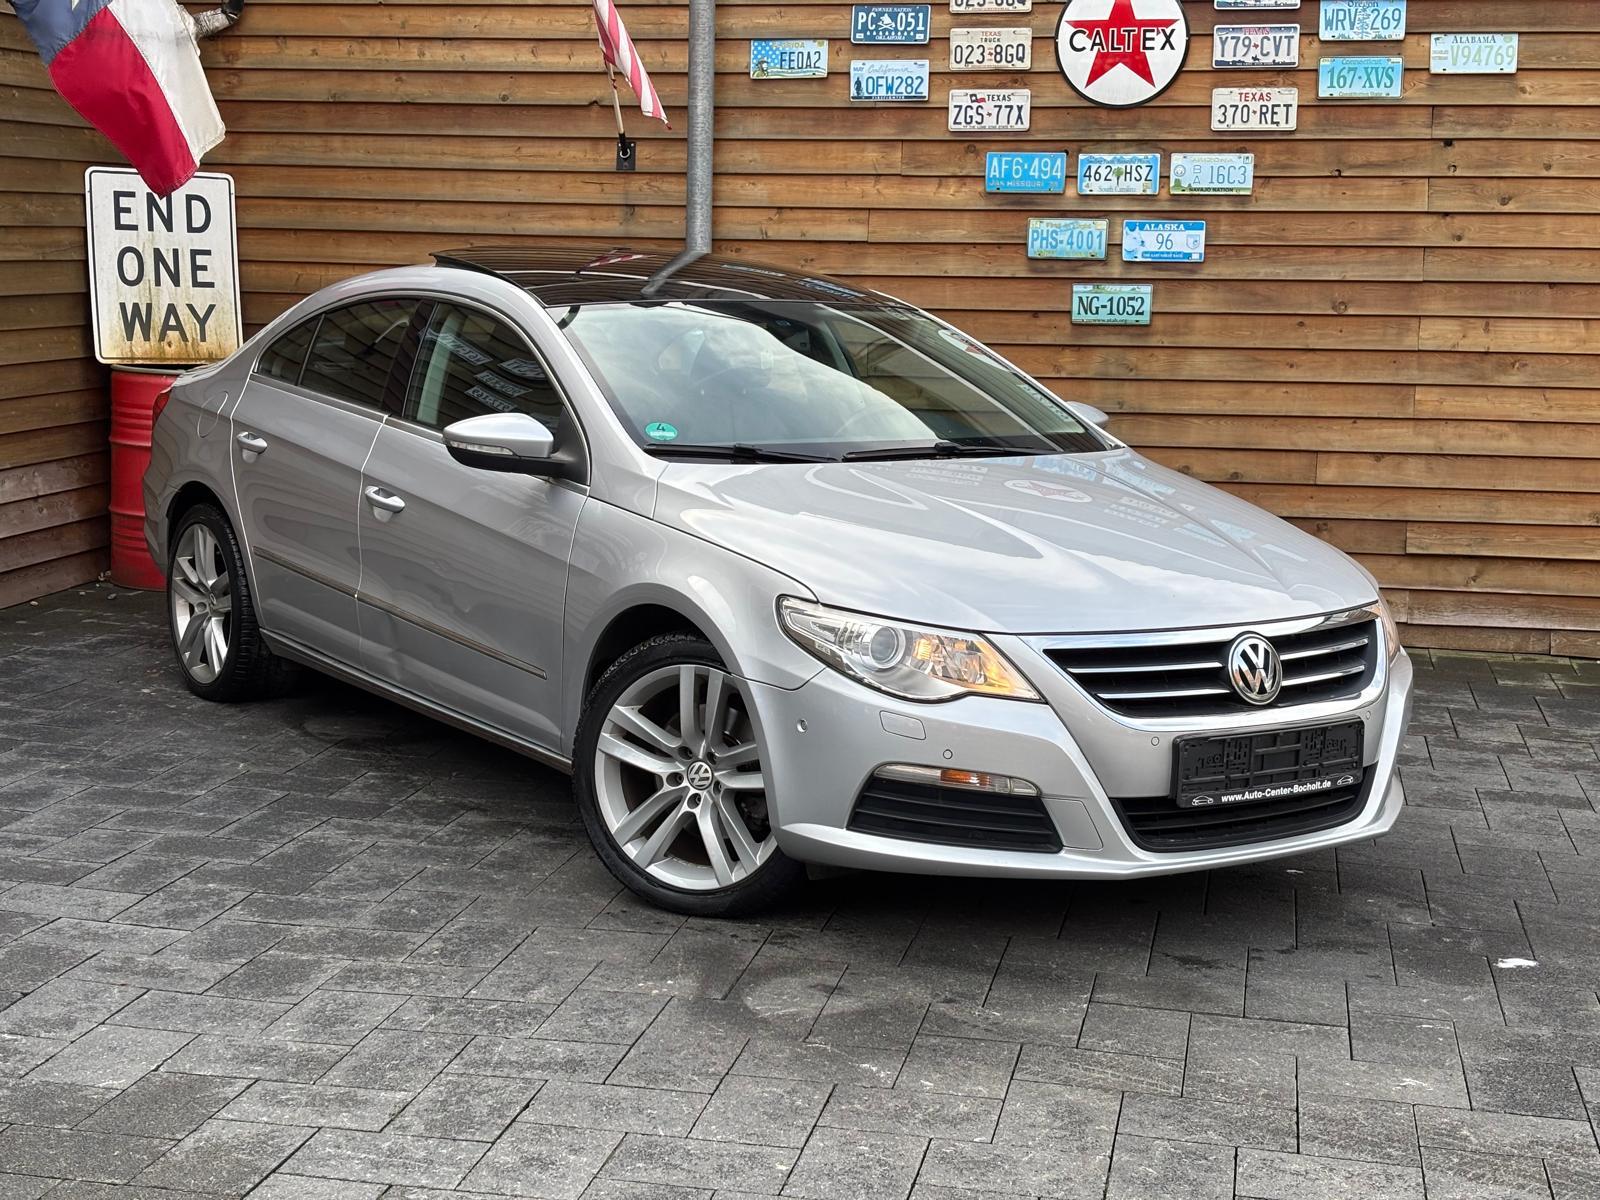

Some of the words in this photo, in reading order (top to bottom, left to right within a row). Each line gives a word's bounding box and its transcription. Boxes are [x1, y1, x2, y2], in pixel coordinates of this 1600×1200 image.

[857, 12, 877, 30] PC
[897, 12, 925, 31] 051
[1324, 8, 1359, 31] WRV
[1370, 8, 1402, 31] 269
[1069, 28, 1177, 53] CALTEX
[1243, 27, 1270, 35] TEXAS
[1451, 35, 1497, 44] ALABAMA
[954, 44, 986, 64] 023
[993, 43, 1026, 63] 8GQ
[1218, 35, 1252, 57] Y79
[1260, 35, 1295, 57] CVT
[1450, 45, 1515, 66] V94769
[987, 94, 1012, 102] TEXAS
[1238, 92, 1272, 102] TEXAS
[952, 105, 985, 125] ZGS
[993, 105, 1024, 125] 77X
[1217, 104, 1251, 125] 370
[1259, 104, 1293, 125] RET
[1083, 165, 1113, 182] 462
[1124, 165, 1154, 182] HSZ
[1208, 165, 1247, 185] 16C3
[113, 190, 212, 234] END
[1143, 223, 1185, 231] ALASKA
[1030, 229, 1104, 250] PHS-4001
[1155, 233, 1174, 250] 96
[116, 246, 216, 289] ONE
[1077, 295, 1145, 316] NG-1052
[118, 302, 217, 343] WAY
[1221, 779, 1332, 803] www.Auto-Center-Bocholt.de
